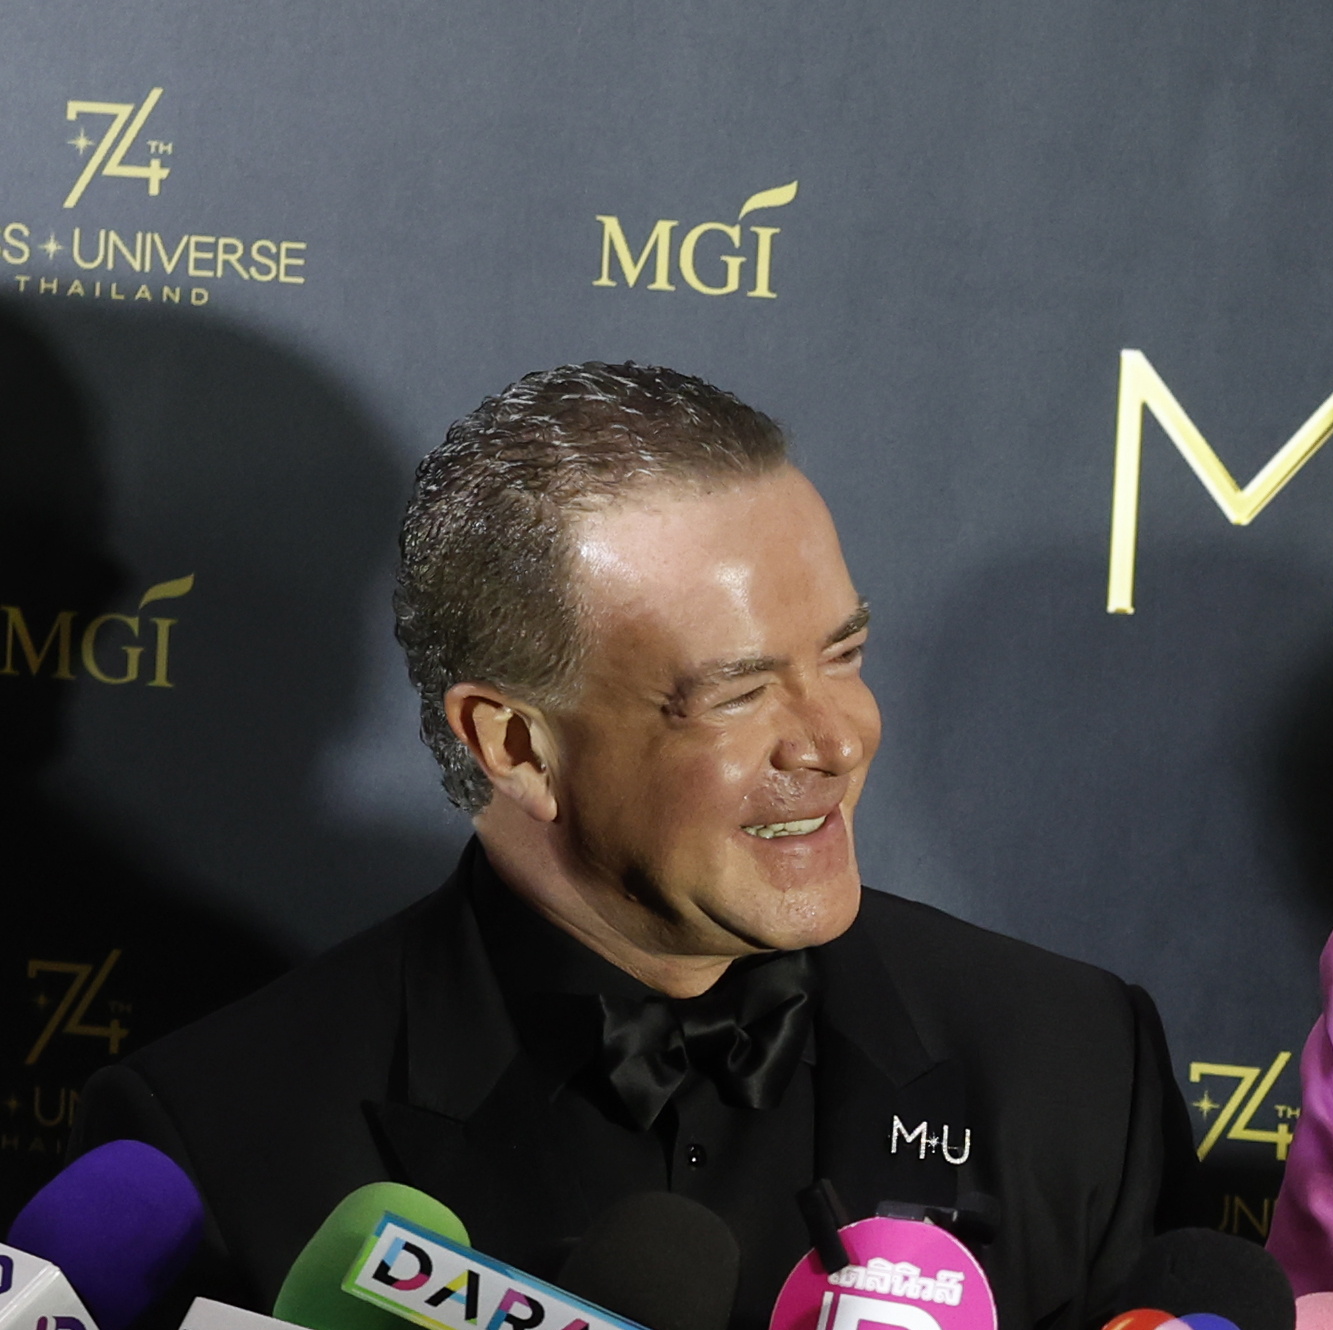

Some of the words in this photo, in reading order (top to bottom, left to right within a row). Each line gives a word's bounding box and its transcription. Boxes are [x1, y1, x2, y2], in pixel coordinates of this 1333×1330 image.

[66, 87, 163, 208] 74
[15, 276, 210, 307] THAILAND
[74, 228, 307, 285] UNIVERSE
[593, 214, 780, 299] MGI
[2, 607, 176, 688] MGI
[24, 949, 130, 1065] 74
[1189, 1051, 1292, 1163] 74
